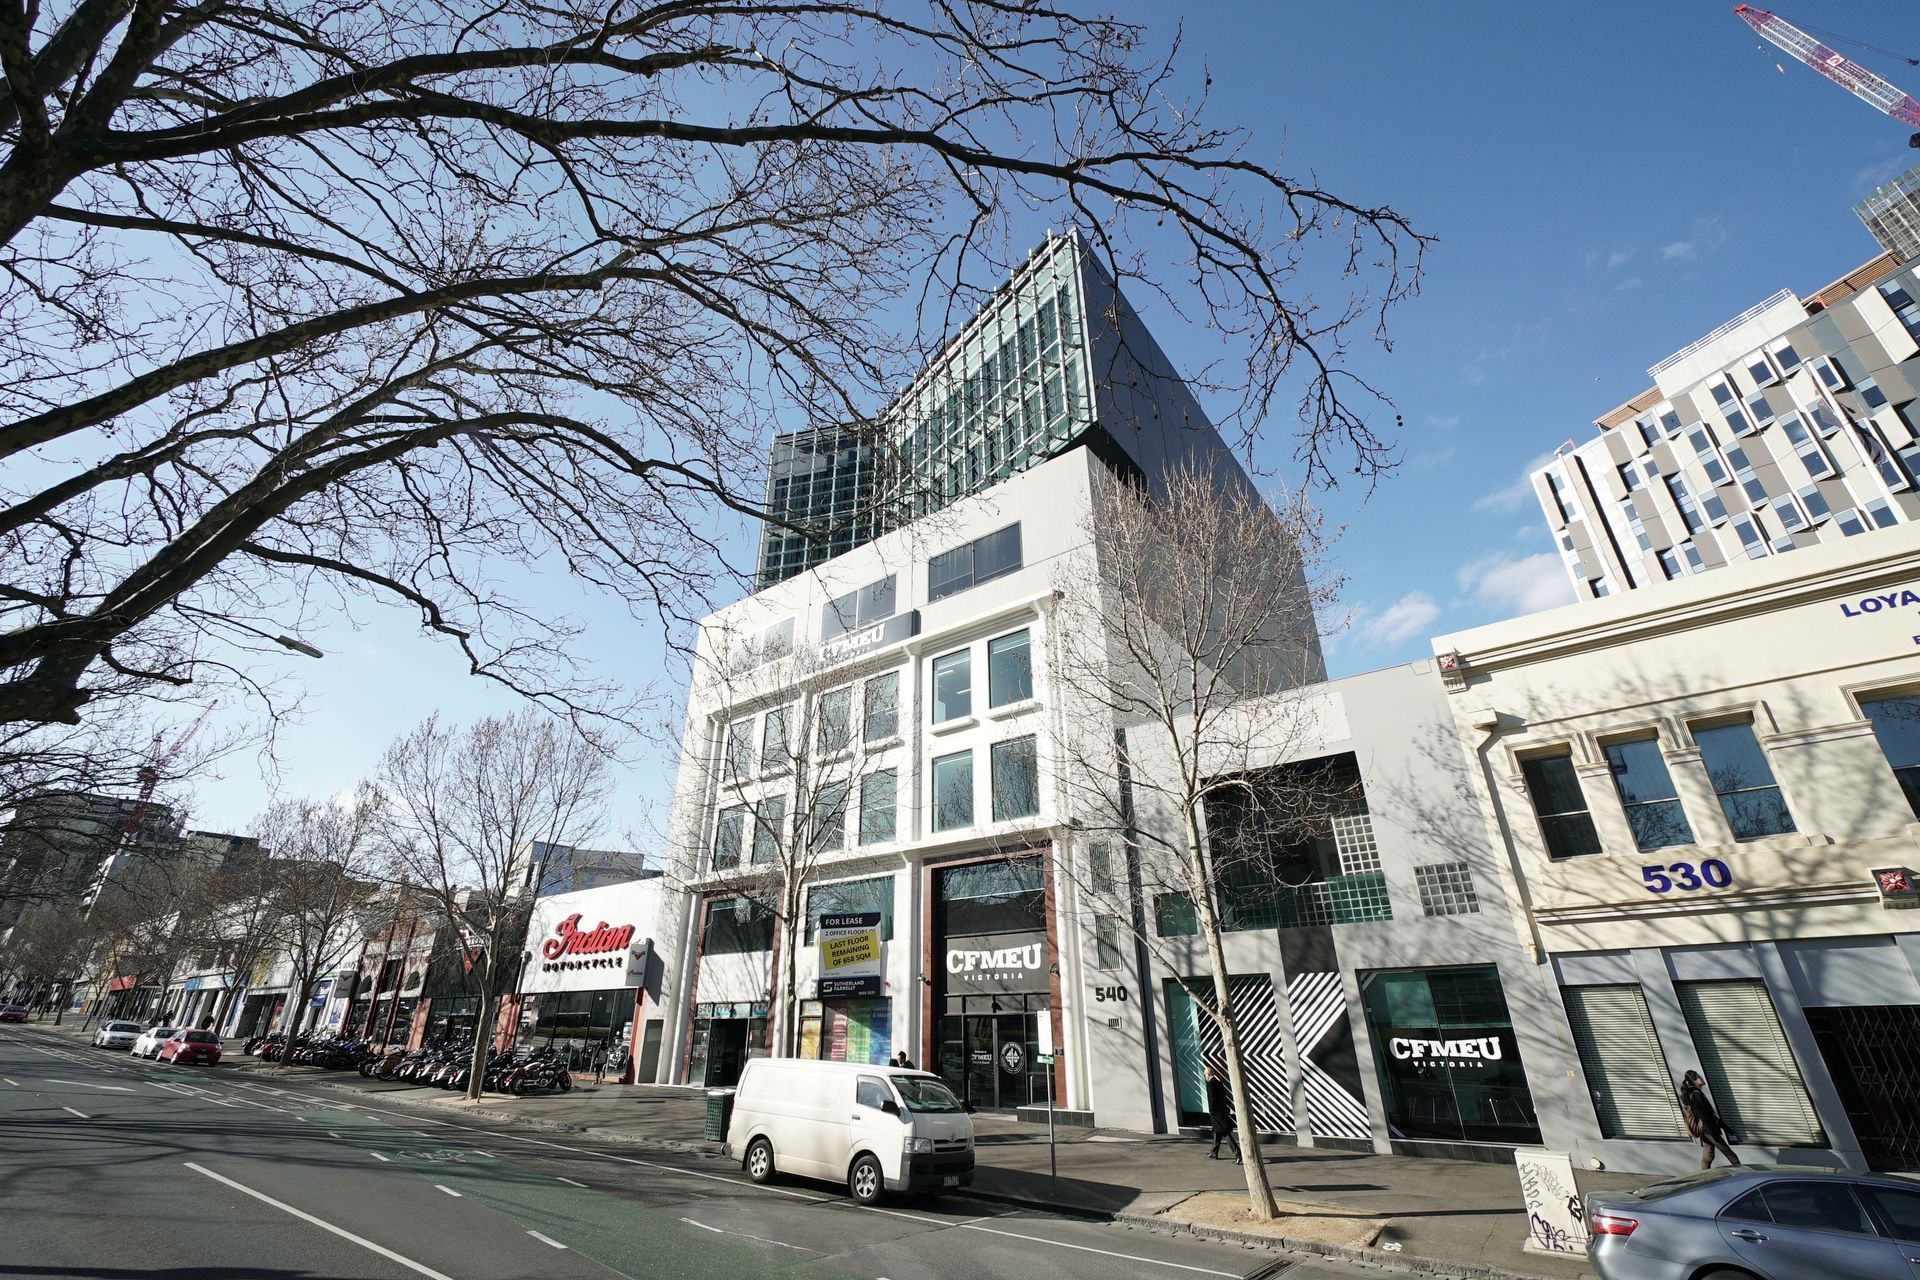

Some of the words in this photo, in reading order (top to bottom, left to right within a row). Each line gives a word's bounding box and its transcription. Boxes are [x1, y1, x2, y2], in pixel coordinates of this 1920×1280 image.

[1641, 859, 1732, 893] 530
[825, 918, 840, 926] FOR
[842, 917, 863, 925] LEASE
[543, 913, 635, 960] Indian
[830, 940, 846, 949] LAST
[847, 935, 869, 945] FLOOR
[832, 944, 870, 958] REMAINING
[842, 956, 855, 964] 658
[855, 952, 872, 961] SQM
[946, 943, 1042, 974] CFMEU
[964, 973, 1023, 981] VICTORIA
[1095, 986, 1128, 1002] 540
[1389, 1037, 1502, 1060] CFMEU
